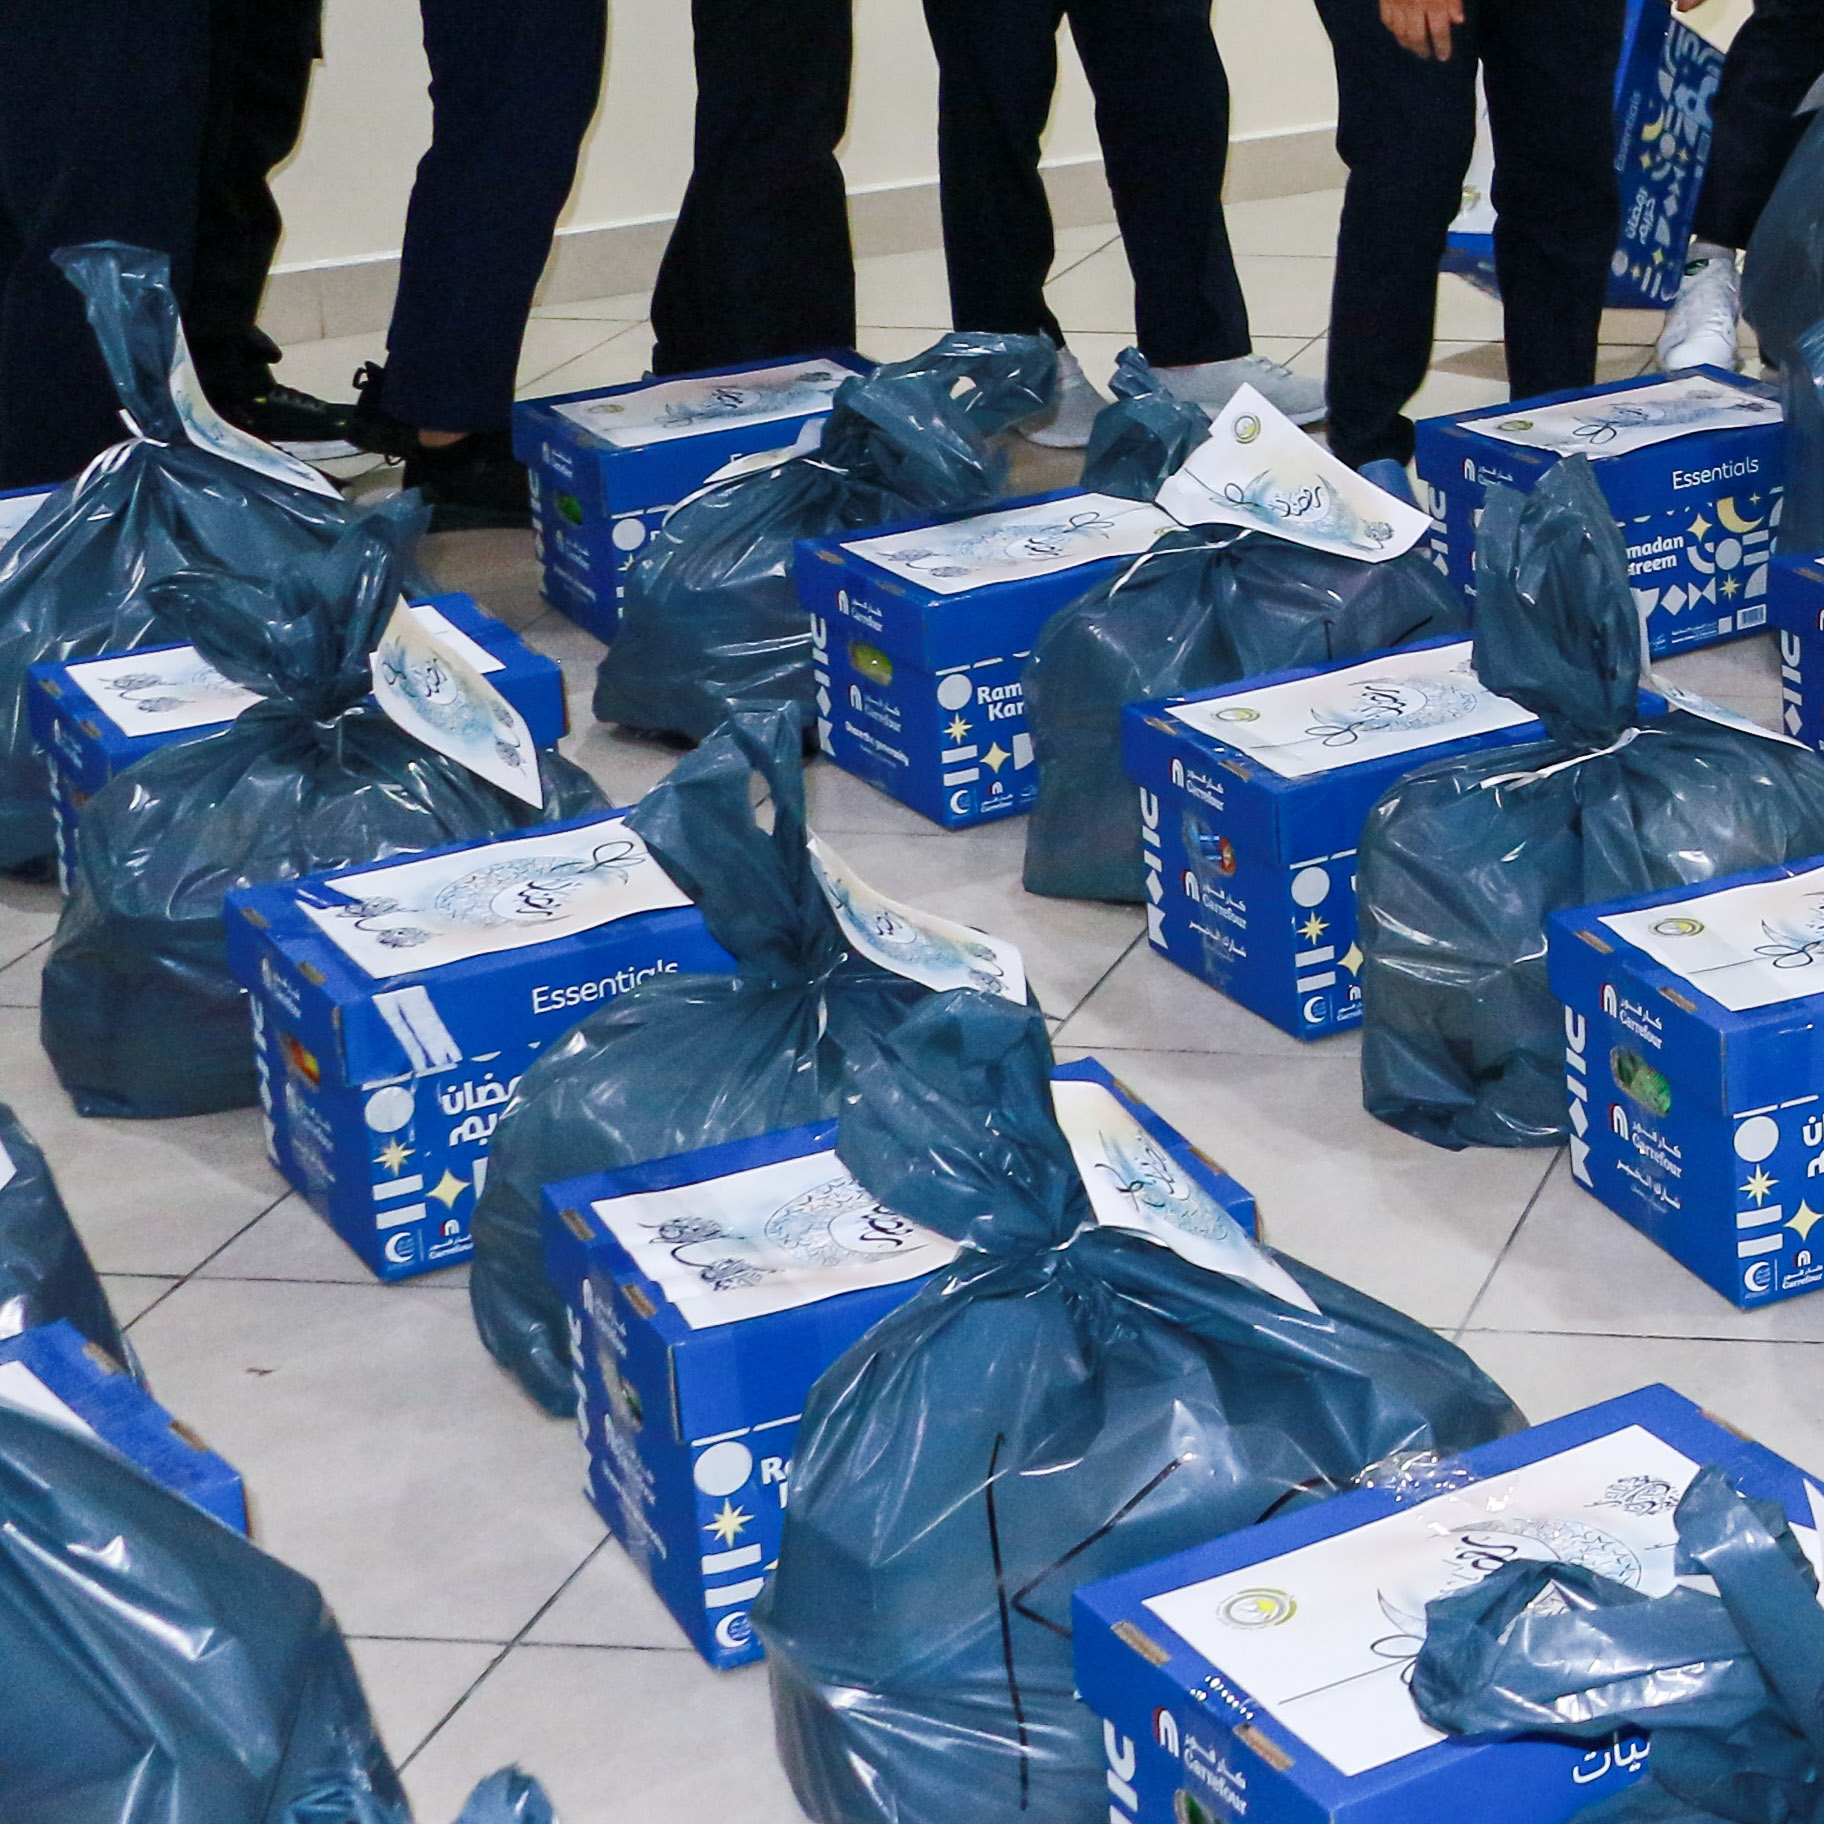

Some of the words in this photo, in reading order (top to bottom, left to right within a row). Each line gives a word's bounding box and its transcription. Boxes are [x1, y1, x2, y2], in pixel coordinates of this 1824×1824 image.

[1672, 457, 1759, 490] Essentials
[1627, 536, 1684, 559] madan
[988, 701, 1025, 721] Kar
[1620, 1011, 1662, 1049] Carrefour
[1184, 1748, 1247, 1815] Carrefour
